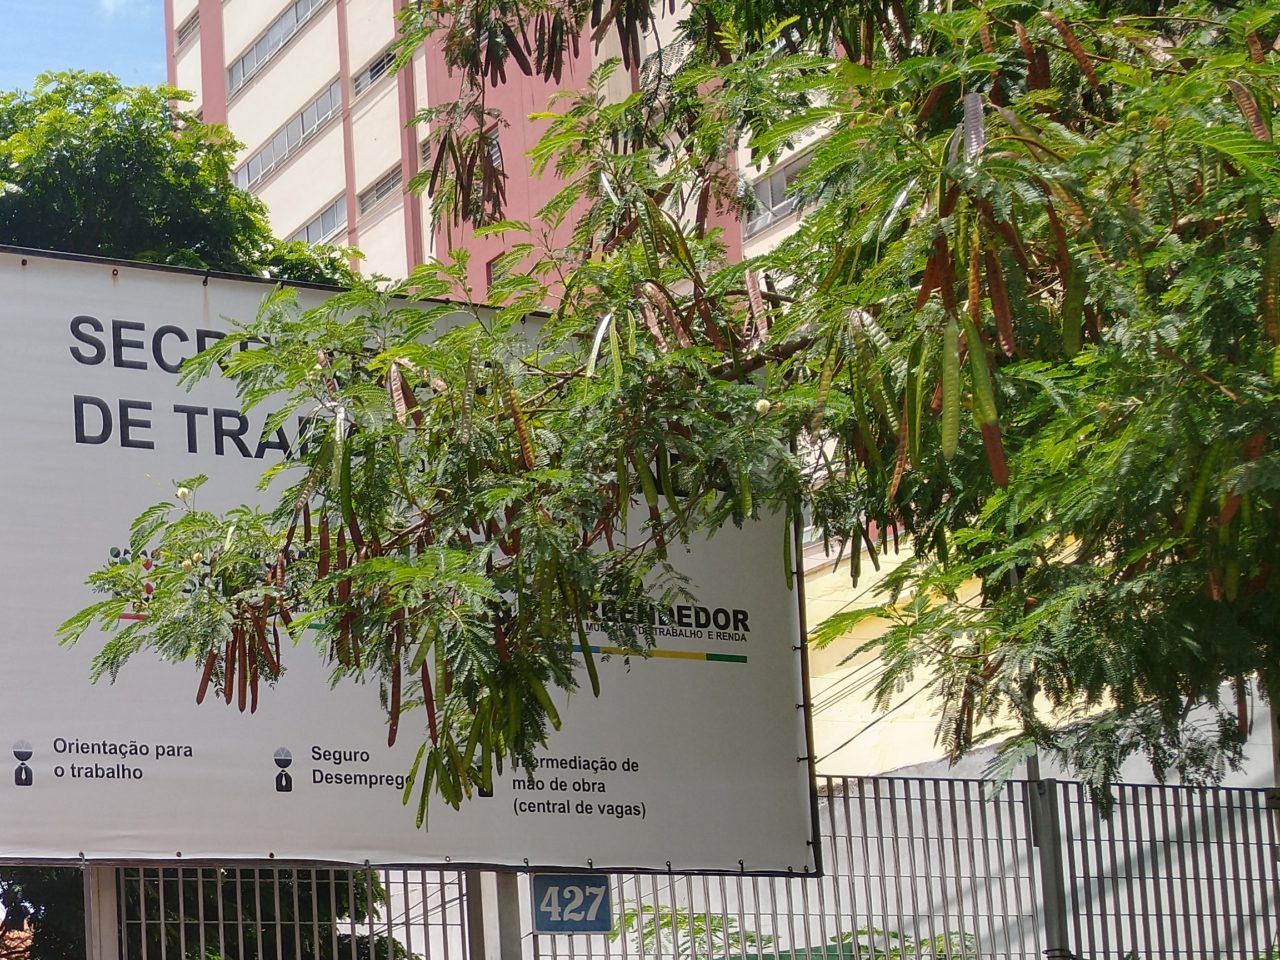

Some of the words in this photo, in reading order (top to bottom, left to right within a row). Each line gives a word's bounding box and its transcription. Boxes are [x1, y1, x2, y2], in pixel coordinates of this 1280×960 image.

[73, 394, 155, 450] DE
[653, 627, 703, 640] TRABALHO
[708, 631, 715, 641] E
[716, 631, 748, 643] RENDA
[53, 737, 150, 759] Orientação
[155, 744, 193, 760] para
[311, 745, 370, 765] Seguro
[54, 765, 65, 777] o
[70, 763, 143, 780] trabalho
[621, 758, 639, 772] de
[549, 777, 568, 791] de
[572, 778, 606, 793] obra
[513, 798, 570, 816] (central
[575, 800, 593, 815] de
[597, 802, 647, 820] vagas)
[540, 886, 607, 921] 427
